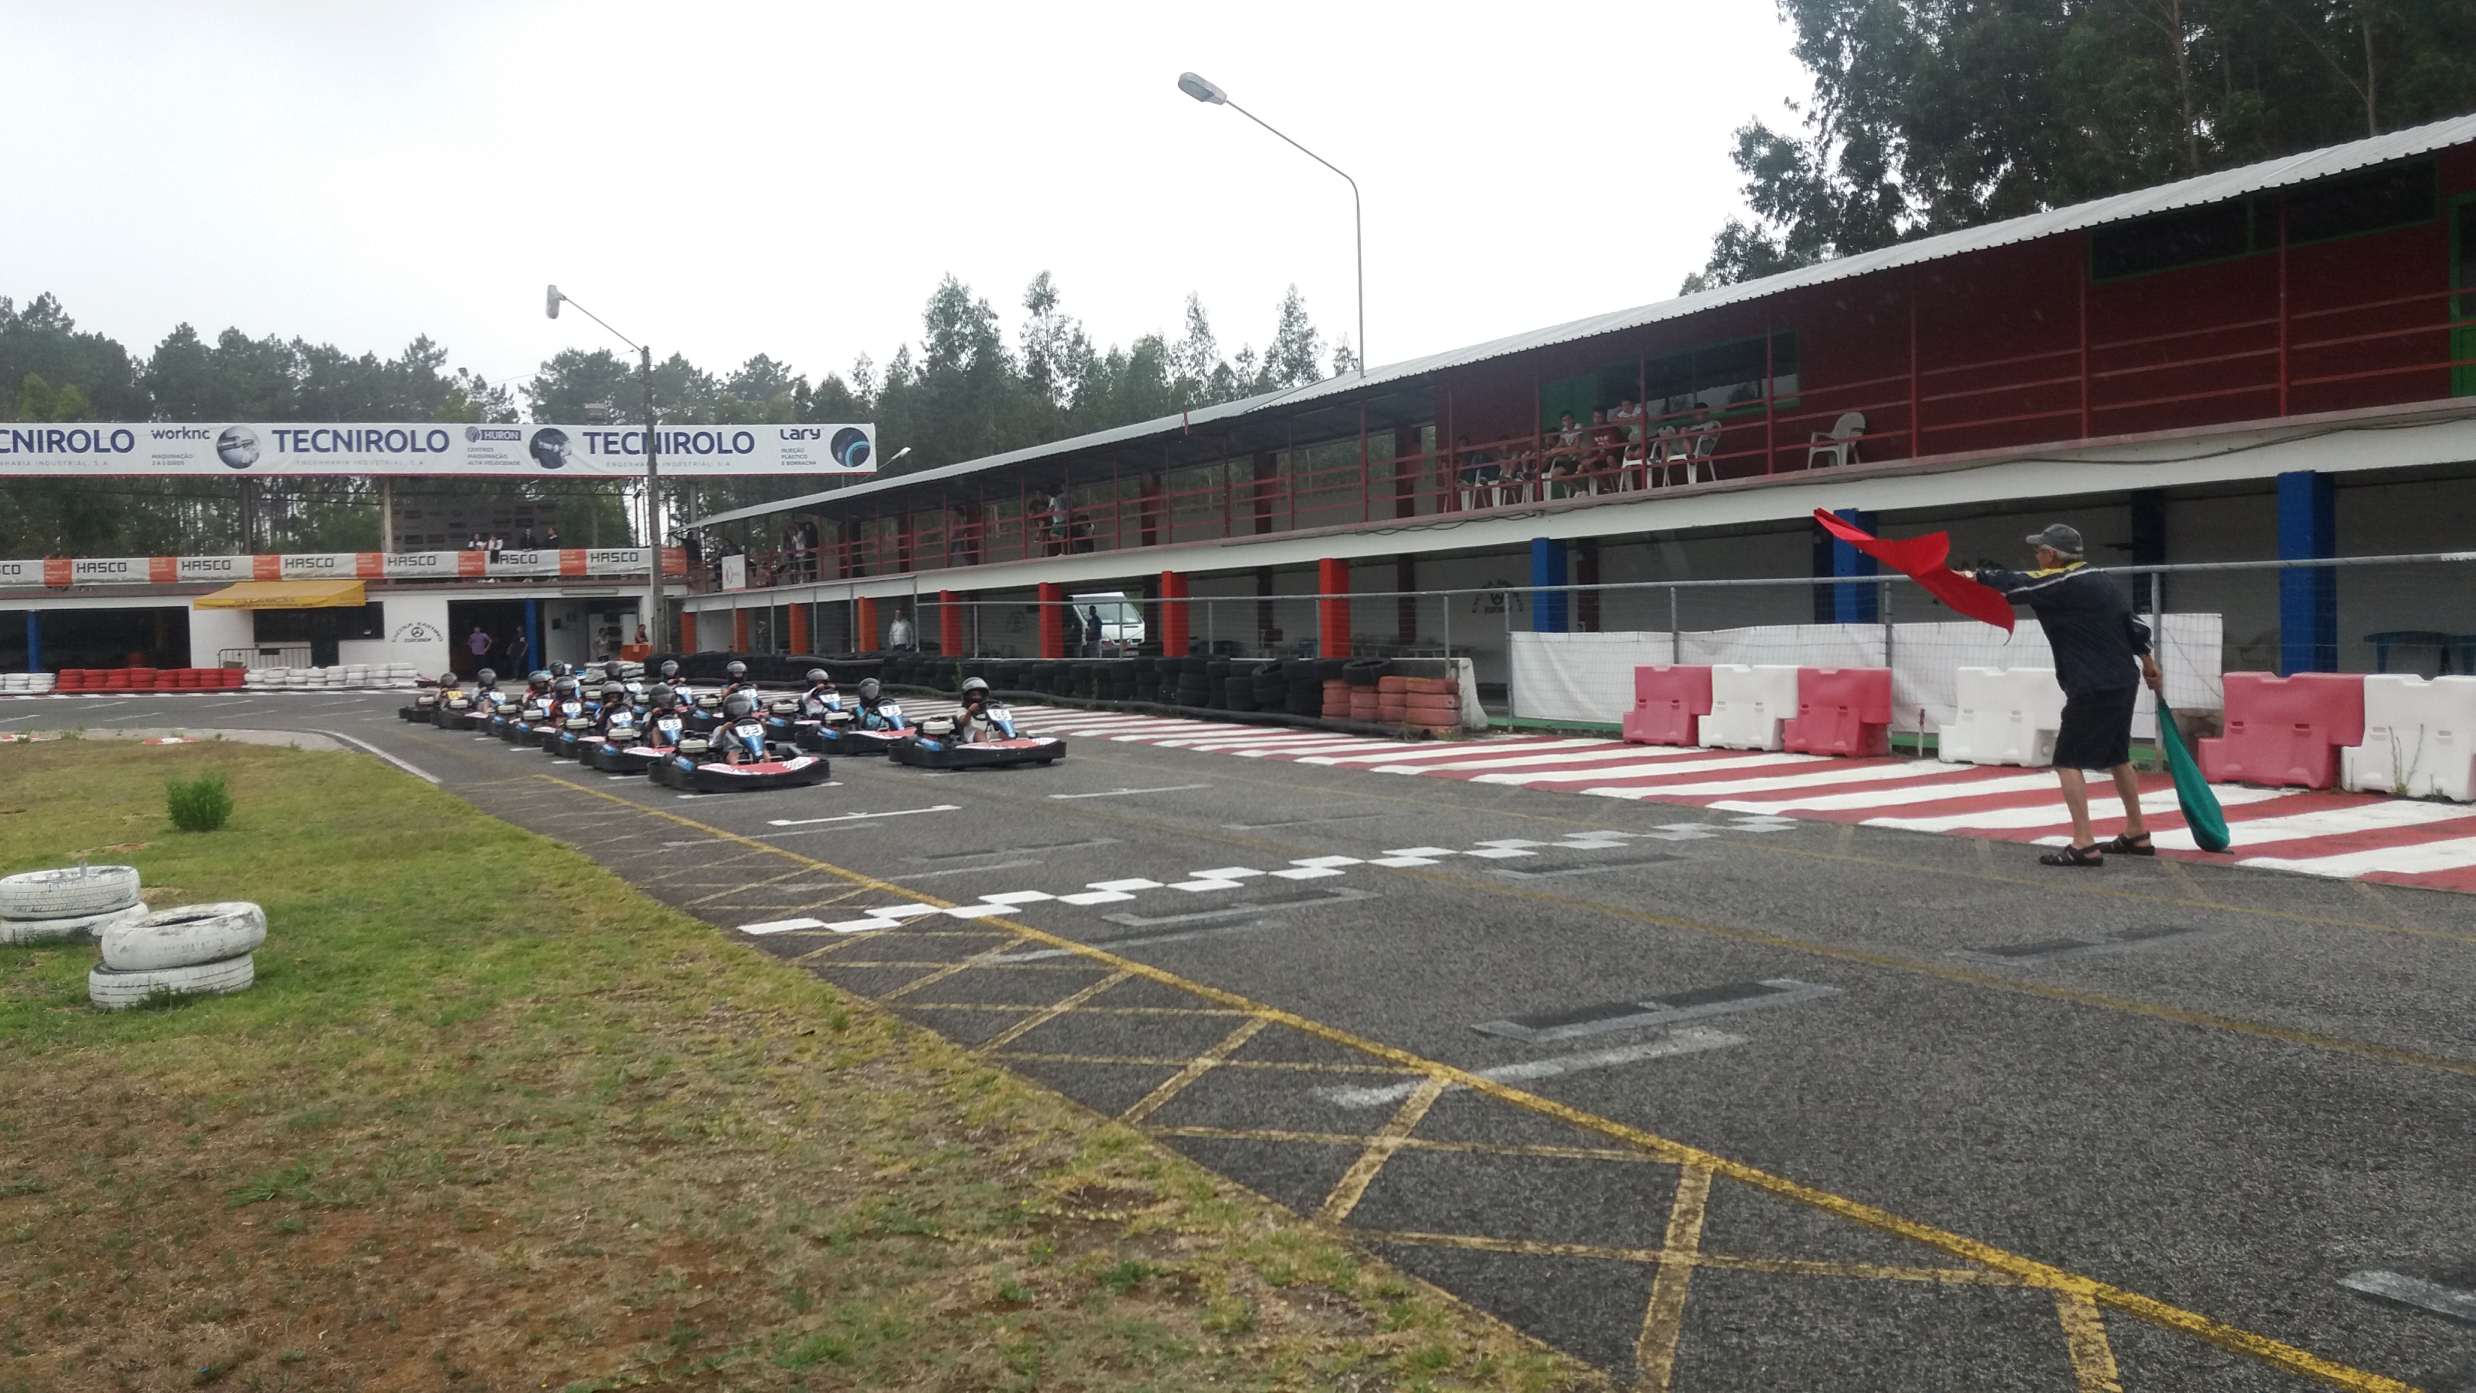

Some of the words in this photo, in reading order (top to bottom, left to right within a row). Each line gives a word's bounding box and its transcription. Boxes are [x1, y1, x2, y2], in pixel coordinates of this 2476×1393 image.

[483, 430, 520, 440] HURON
[272, 429, 450, 453] TECNIROLO
[582, 431, 756, 455] TECNIROLO
[387, 556, 436, 567] HASCO
[499, 554, 538, 564] ASCO
[590, 551, 639, 563] HASCO
[76, 562, 128, 574] HASCO
[181, 560, 231, 571] HASCO
[285, 557, 334, 569] HASCO
[0, 564, 21, 575] CO
